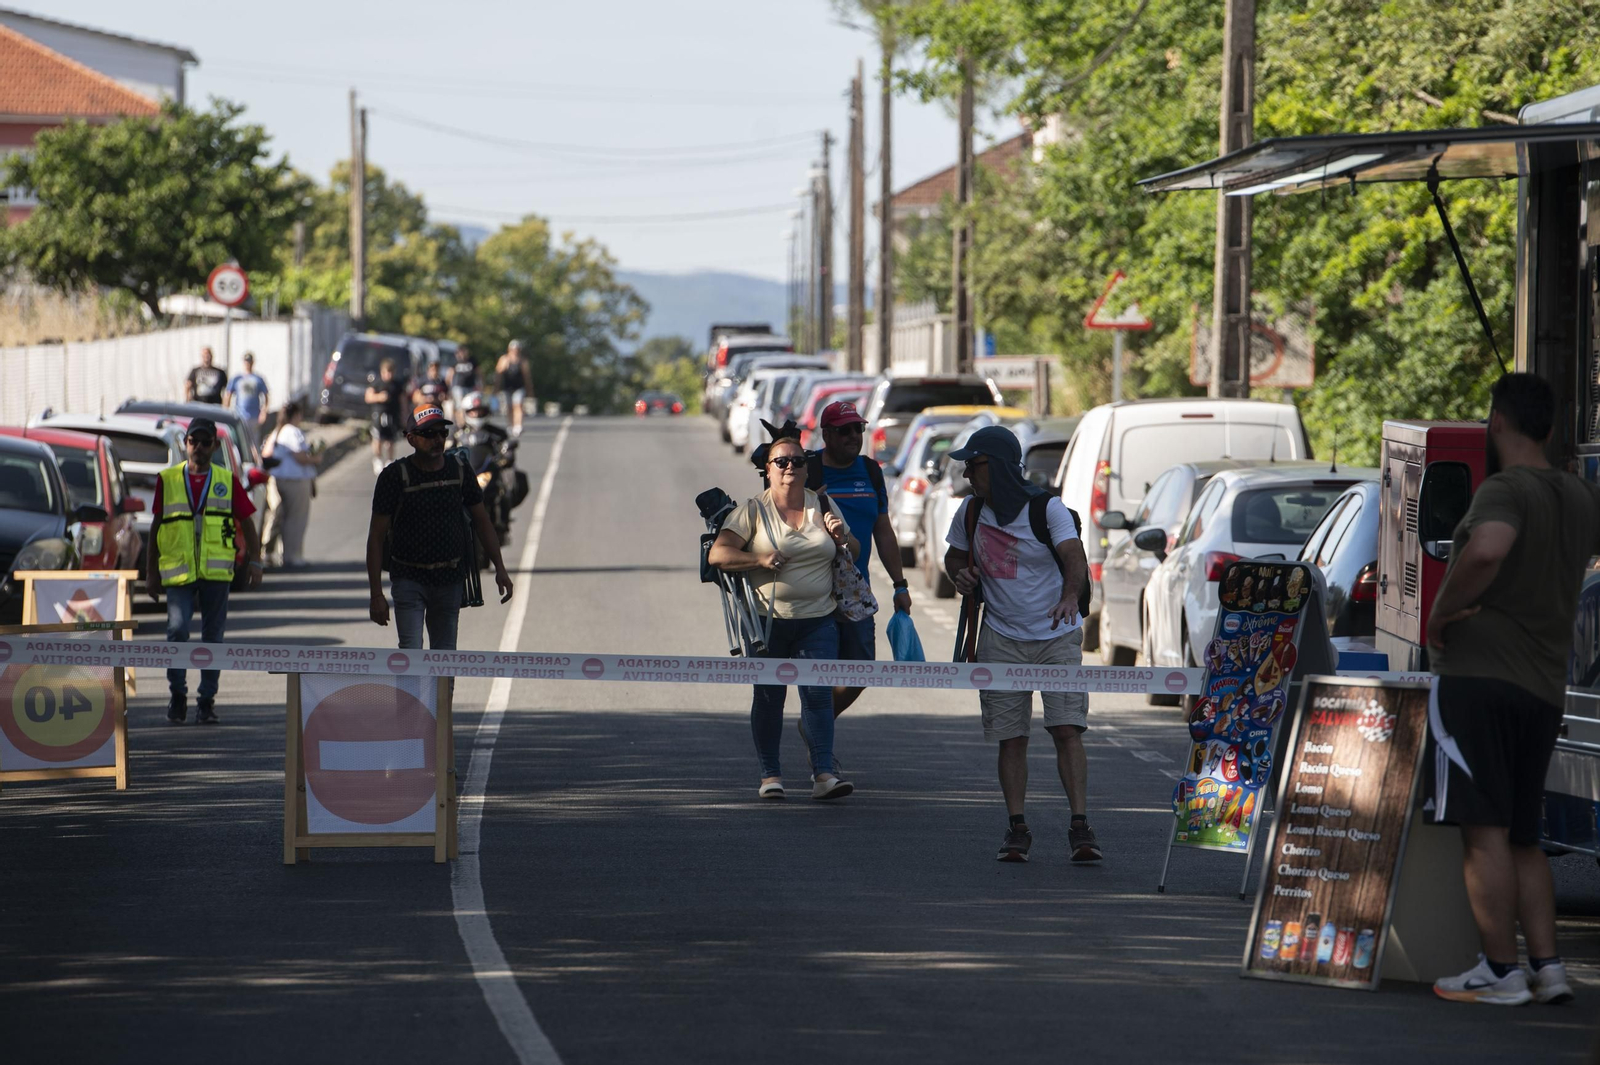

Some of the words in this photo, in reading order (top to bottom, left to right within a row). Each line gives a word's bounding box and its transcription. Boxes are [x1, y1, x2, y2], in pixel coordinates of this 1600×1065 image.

[1304, 741, 1334, 755] Bacón
[1299, 761, 1330, 775] Bacón
[1329, 763, 1362, 778] Queso
[1295, 782, 1323, 795] Lomo
[1290, 803, 1319, 815] Lomo
[1320, 804, 1352, 818] Queso
[1286, 823, 1315, 836] Lomo
[1347, 828, 1381, 842] Queso
[1281, 843, 1321, 857] Chorizo
[1277, 863, 1317, 878] Chorizo
[1318, 867, 1350, 882] Queso
[1273, 884, 1313, 899] Perritos
